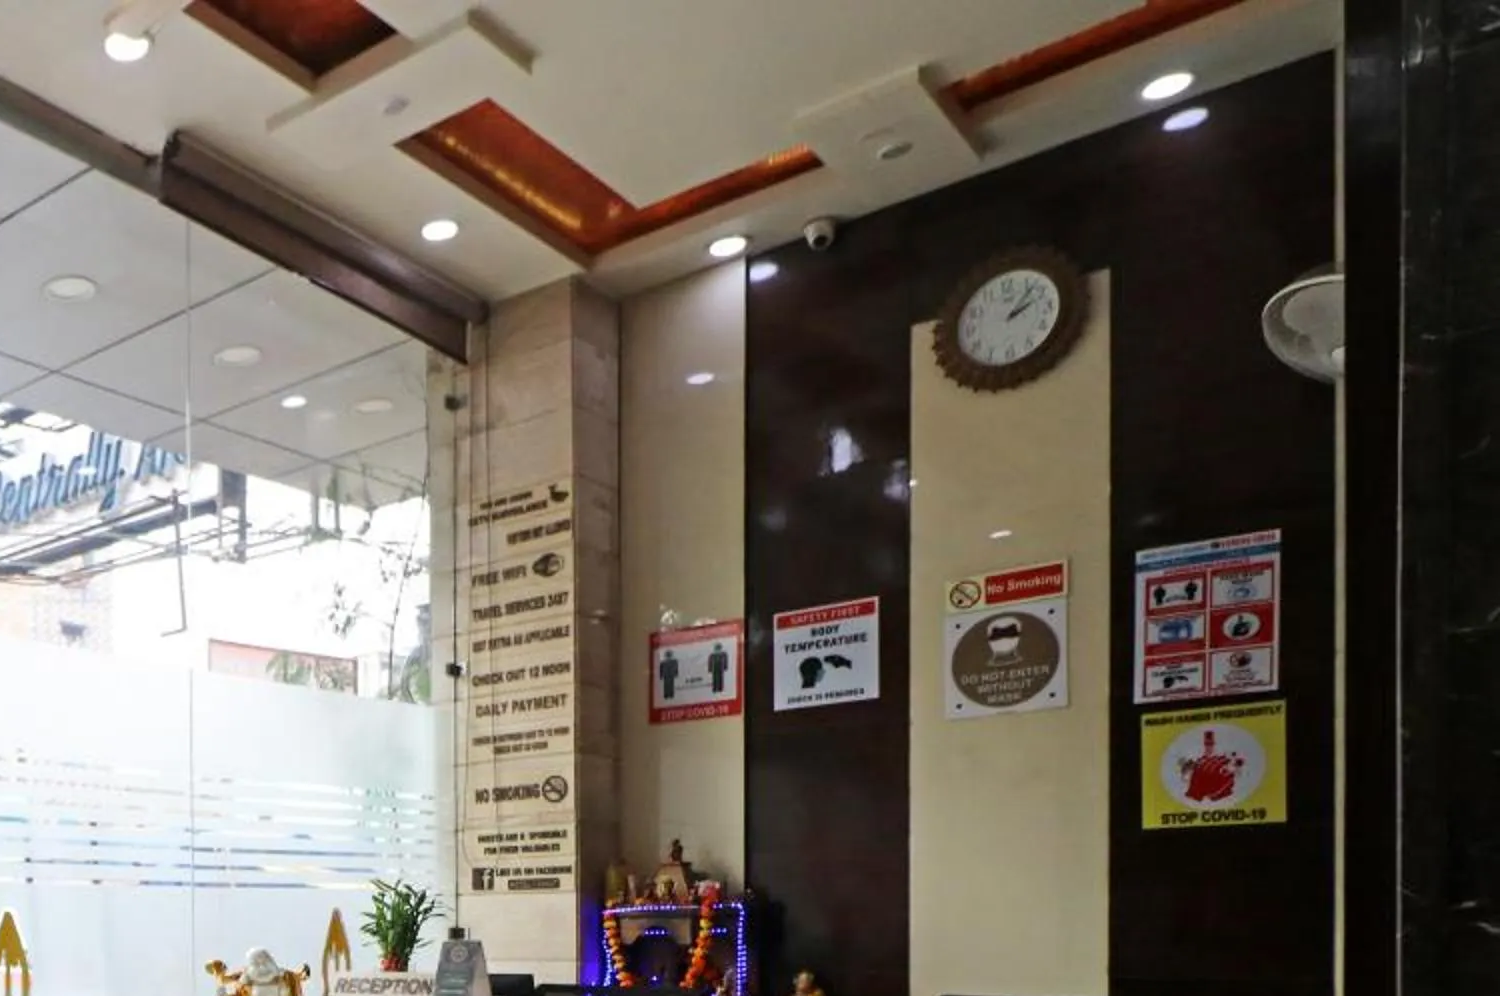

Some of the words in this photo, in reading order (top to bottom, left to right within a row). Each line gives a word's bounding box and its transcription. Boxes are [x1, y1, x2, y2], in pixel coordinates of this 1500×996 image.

[987, 583, 1004, 594] No
[1007, 573, 1061, 592] Smoking
[810, 625, 840, 637] BODY
[784, 633, 868, 654] TEMPERATURE
[505, 667, 526, 682] OUT
[528, 665, 540, 679] 12
[961, 674, 978, 685] DO
[1009, 664, 1050, 680] ENTER
[475, 701, 508, 718] DAILY
[511, 692, 567, 714] PAYMENT
[491, 783, 541, 803] SMOKING
[1161, 811, 1197, 825] STOP
[1201, 807, 1268, 823] COVID-19
[335, 977, 433, 995] RECEPTION
